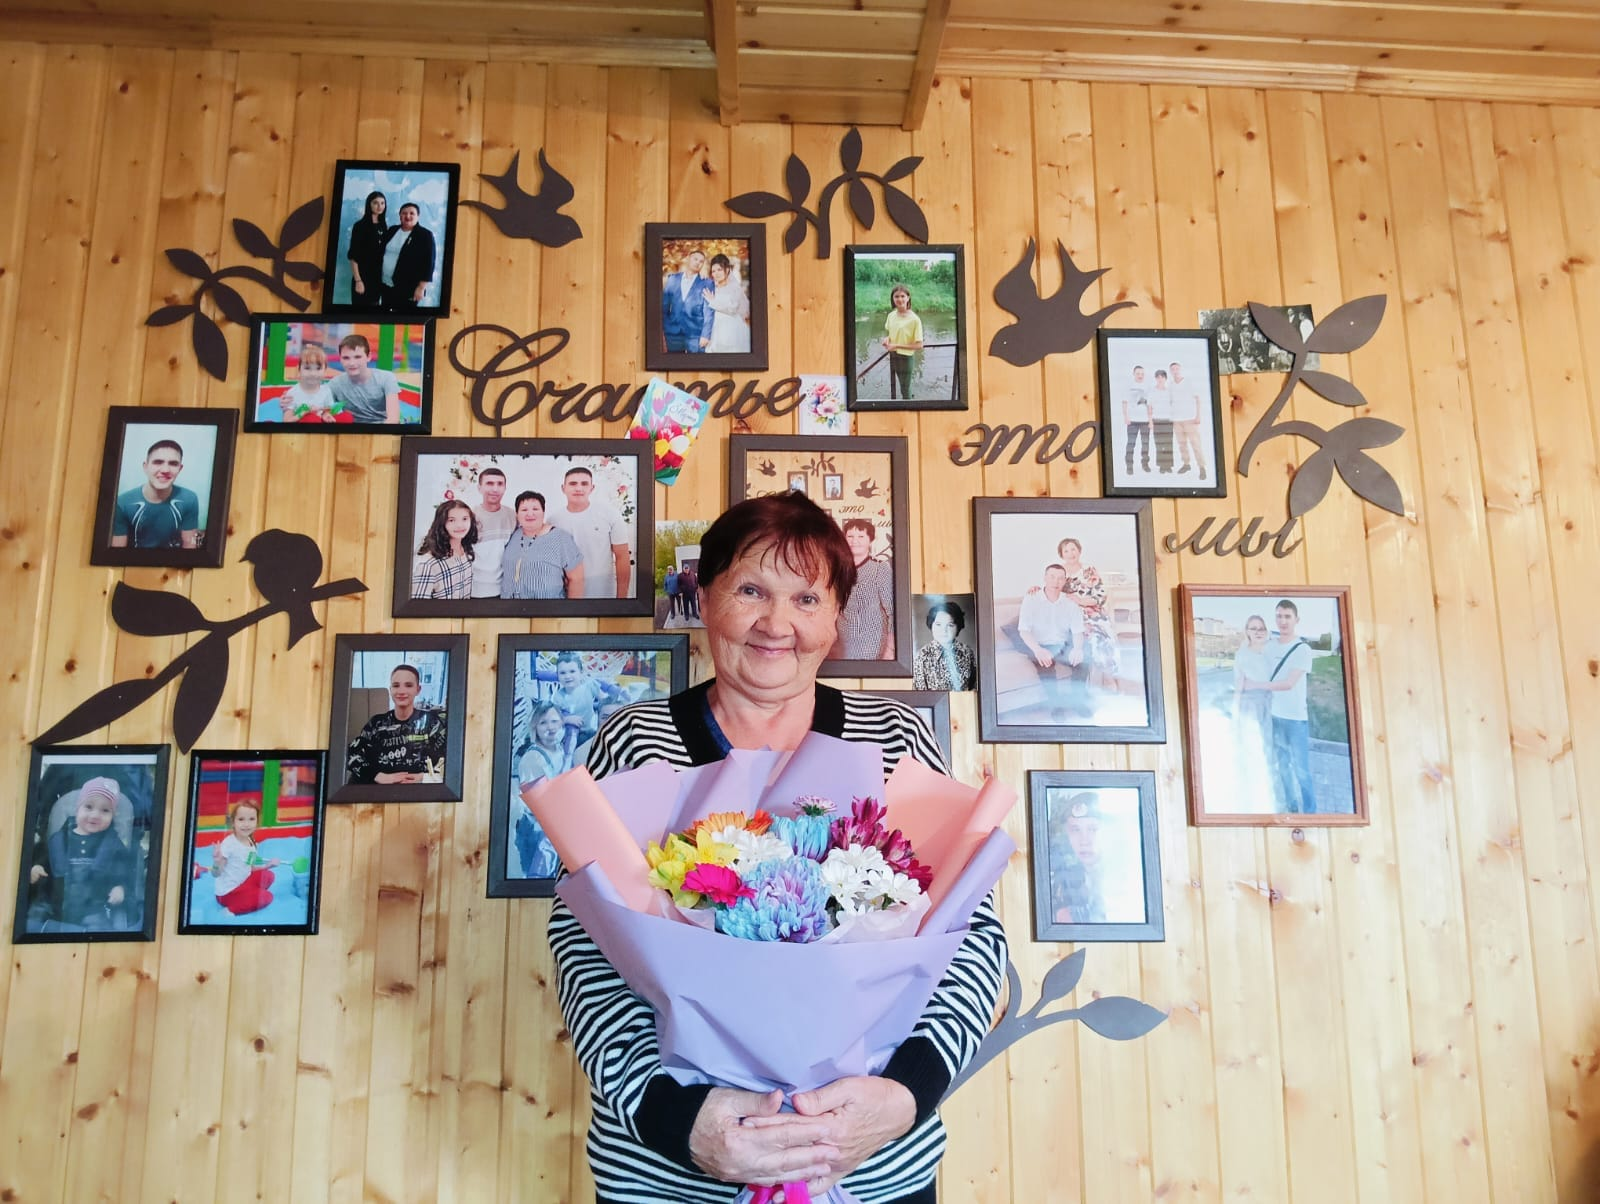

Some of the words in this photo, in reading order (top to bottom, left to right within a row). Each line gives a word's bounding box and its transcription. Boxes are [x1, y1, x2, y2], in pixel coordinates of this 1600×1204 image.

[449, 324, 806, 437] Счатье
[949, 421, 1100, 466] это
[838, 504, 865, 513] это
[1163, 516, 1304, 559] мы
